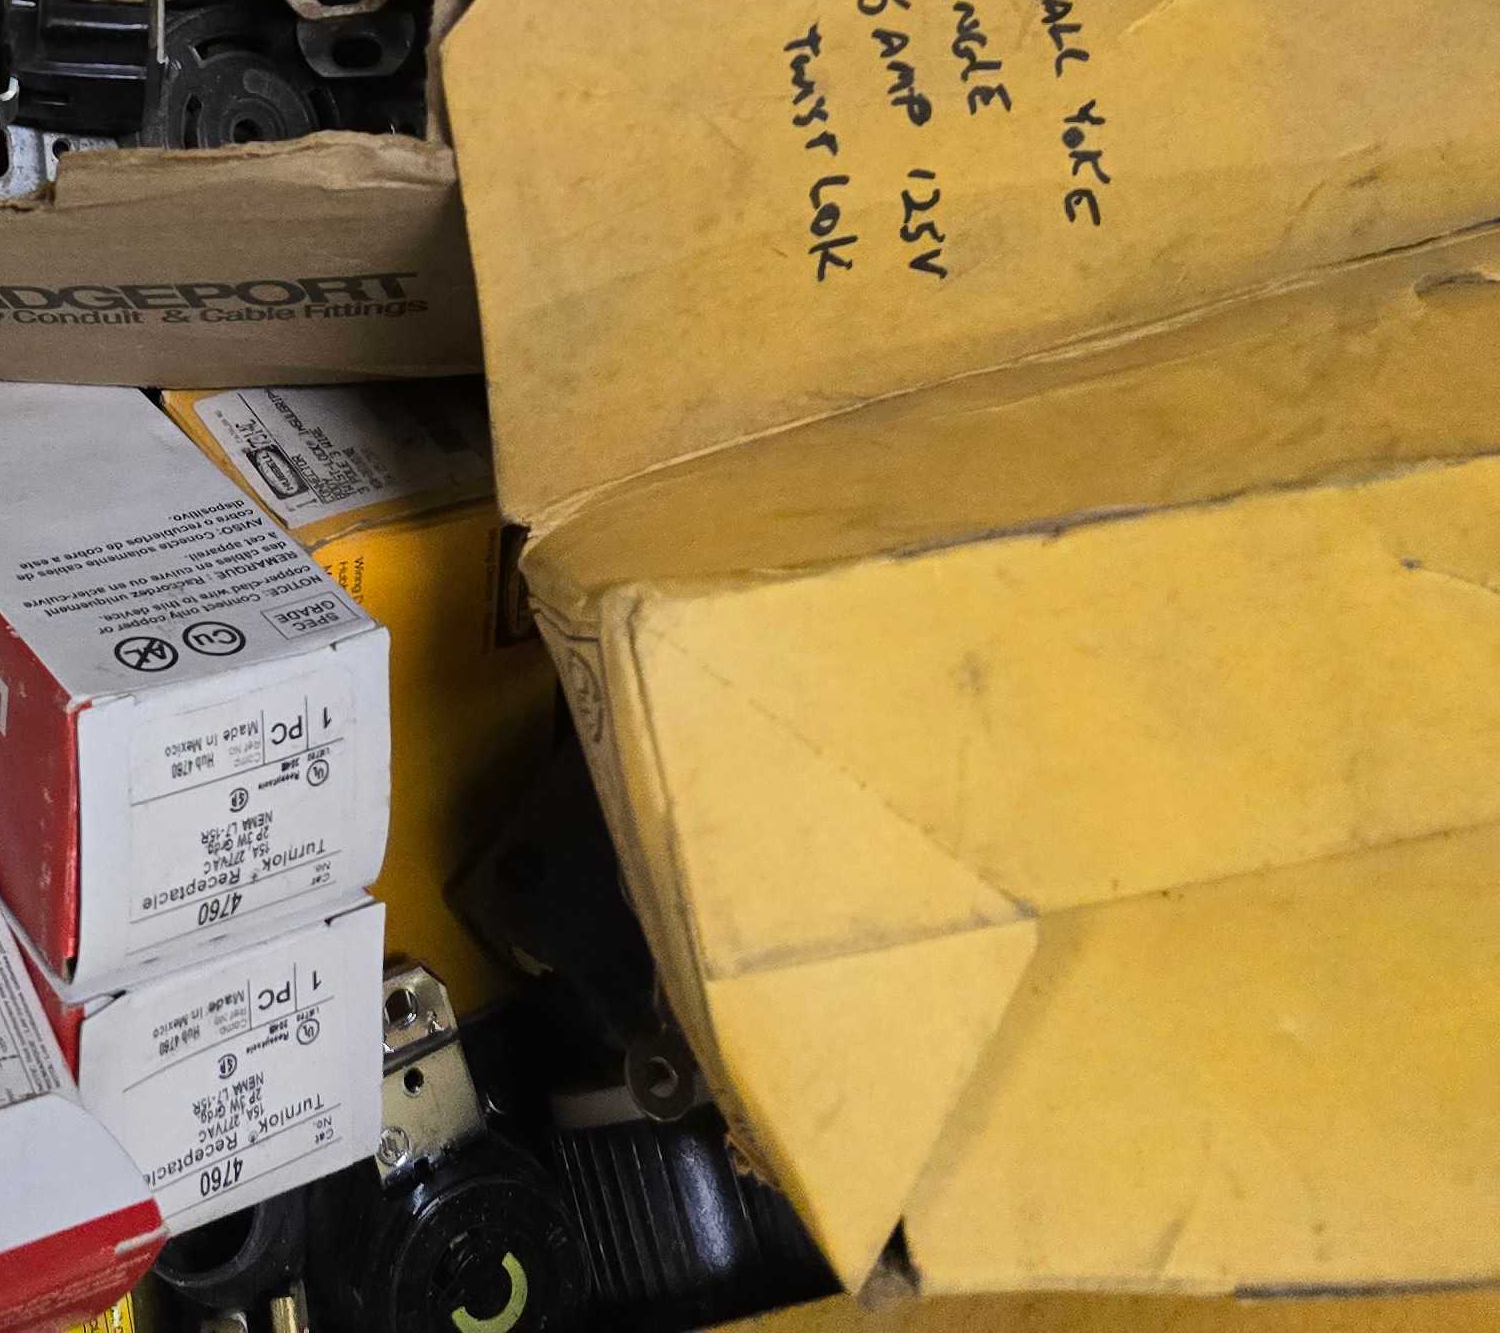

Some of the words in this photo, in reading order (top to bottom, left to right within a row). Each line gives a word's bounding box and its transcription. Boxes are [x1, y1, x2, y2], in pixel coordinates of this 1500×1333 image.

[899, 169, 949, 280] 125V
[11, 308, 145, 326] Conduit
[161, 308, 191, 324] &
[200, 304, 296, 323] Cable
[304, 296, 429, 319] Fittings
[272, 597, 336, 623] GRADE
[289, 610, 340, 633] SPEC
[270, 712, 303, 746] PC
[141, 861, 240, 915] Receptacle
[197, 888, 243, 930] 4760
[257, 980, 292, 1011] PC
[199, 1158, 244, 1198] 4760
